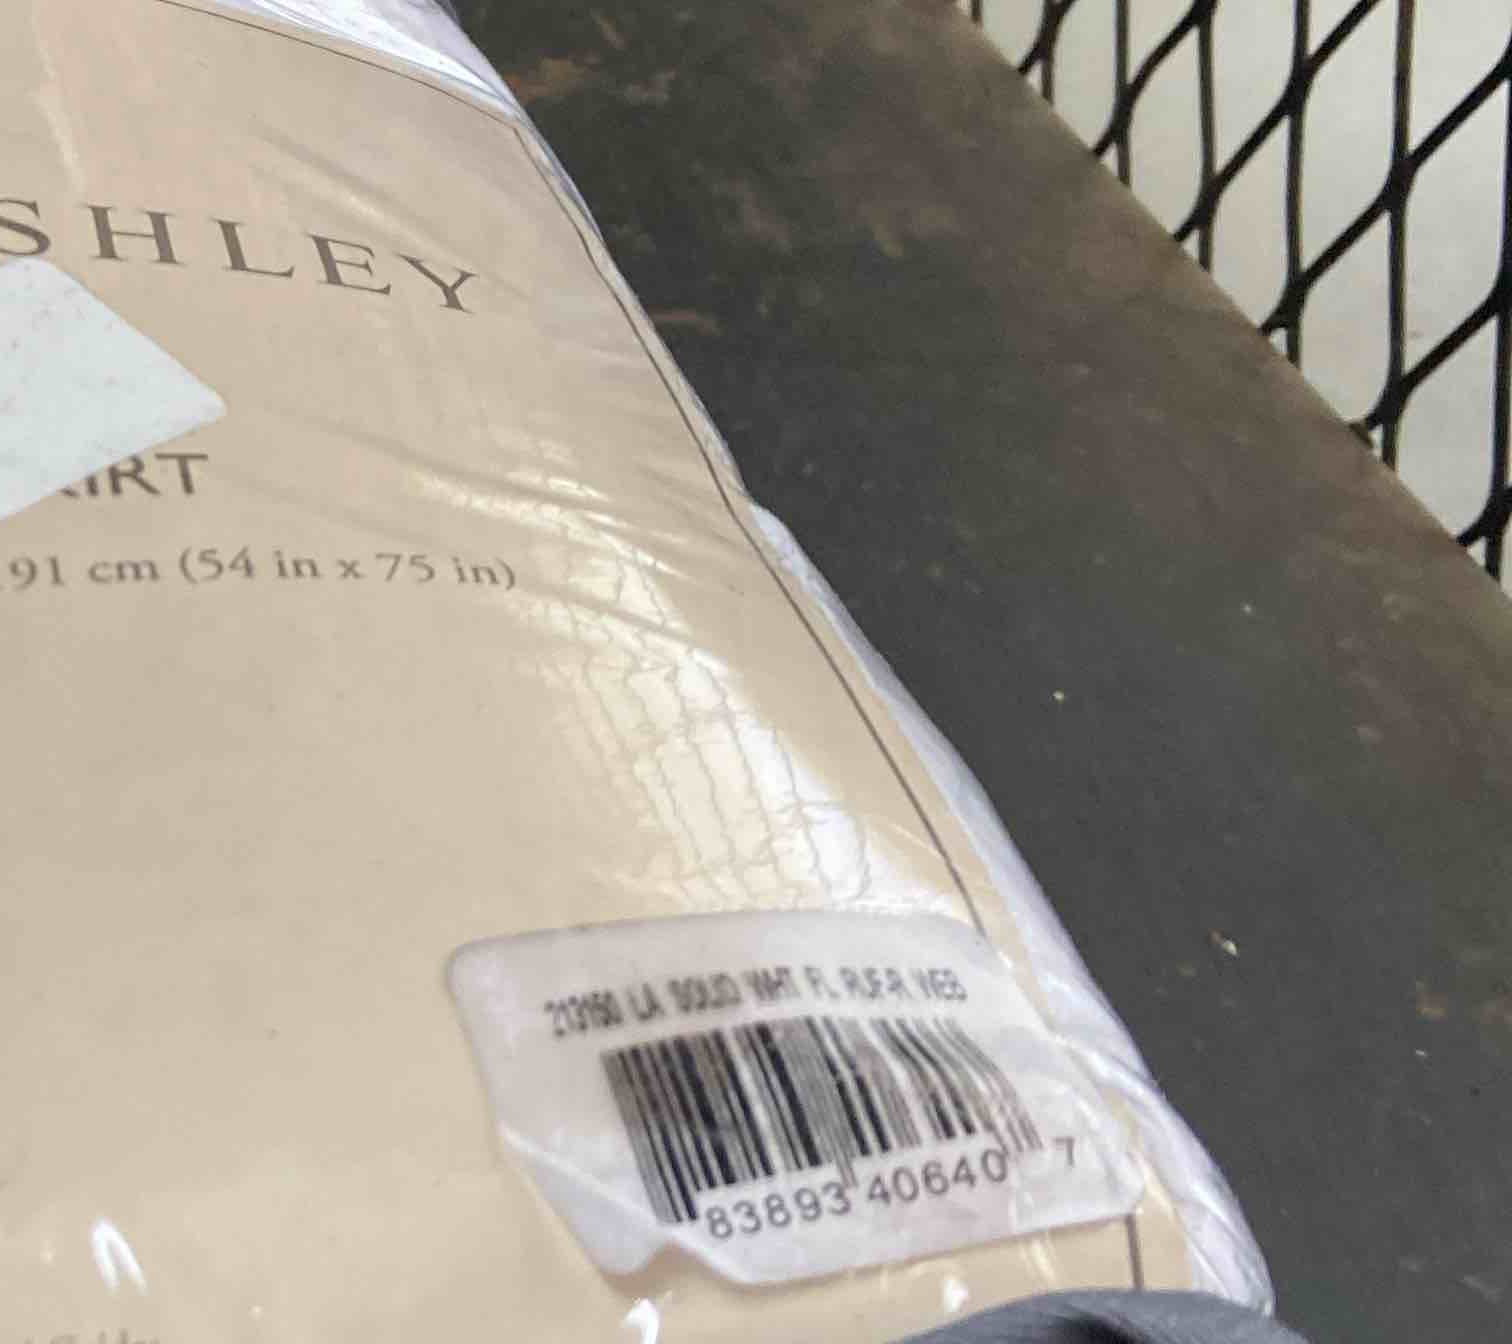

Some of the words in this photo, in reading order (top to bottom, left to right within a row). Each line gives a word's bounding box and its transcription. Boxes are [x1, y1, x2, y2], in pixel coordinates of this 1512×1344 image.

[58, 453, 208, 499] IRT
[87, 558, 160, 584] cm
[178, 546, 255, 585] (54
[273, 550, 320, 580] in
[337, 558, 365, 581] x
[375, 552, 435, 584] 75
[452, 556, 517, 591] in)
[704, 1180, 852, 1240] 83893
[866, 1147, 1009, 1206] 40640
[1051, 1136, 1077, 1169] 7
